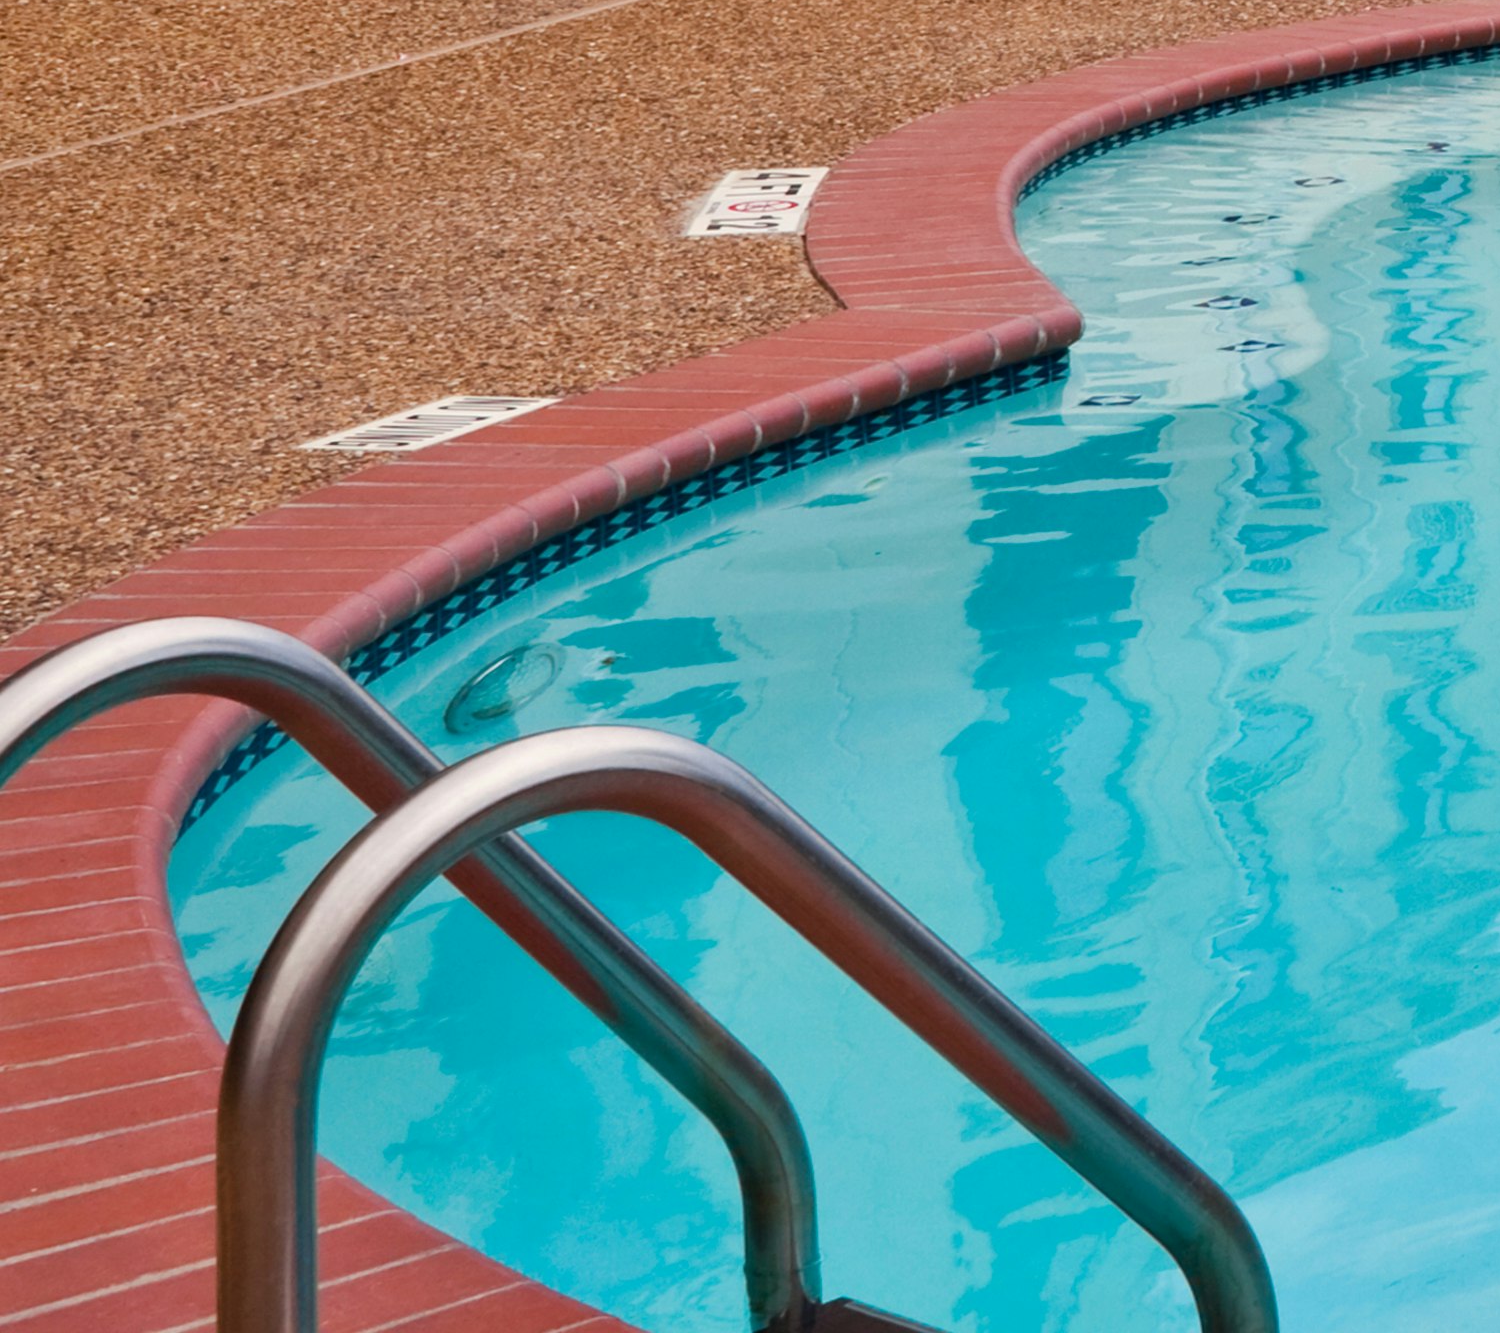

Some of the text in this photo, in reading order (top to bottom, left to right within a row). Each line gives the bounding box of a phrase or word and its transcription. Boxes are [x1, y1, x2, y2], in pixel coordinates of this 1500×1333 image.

[725, 183, 802, 197] FT
[325, 397, 541, 447] NO DIVING
